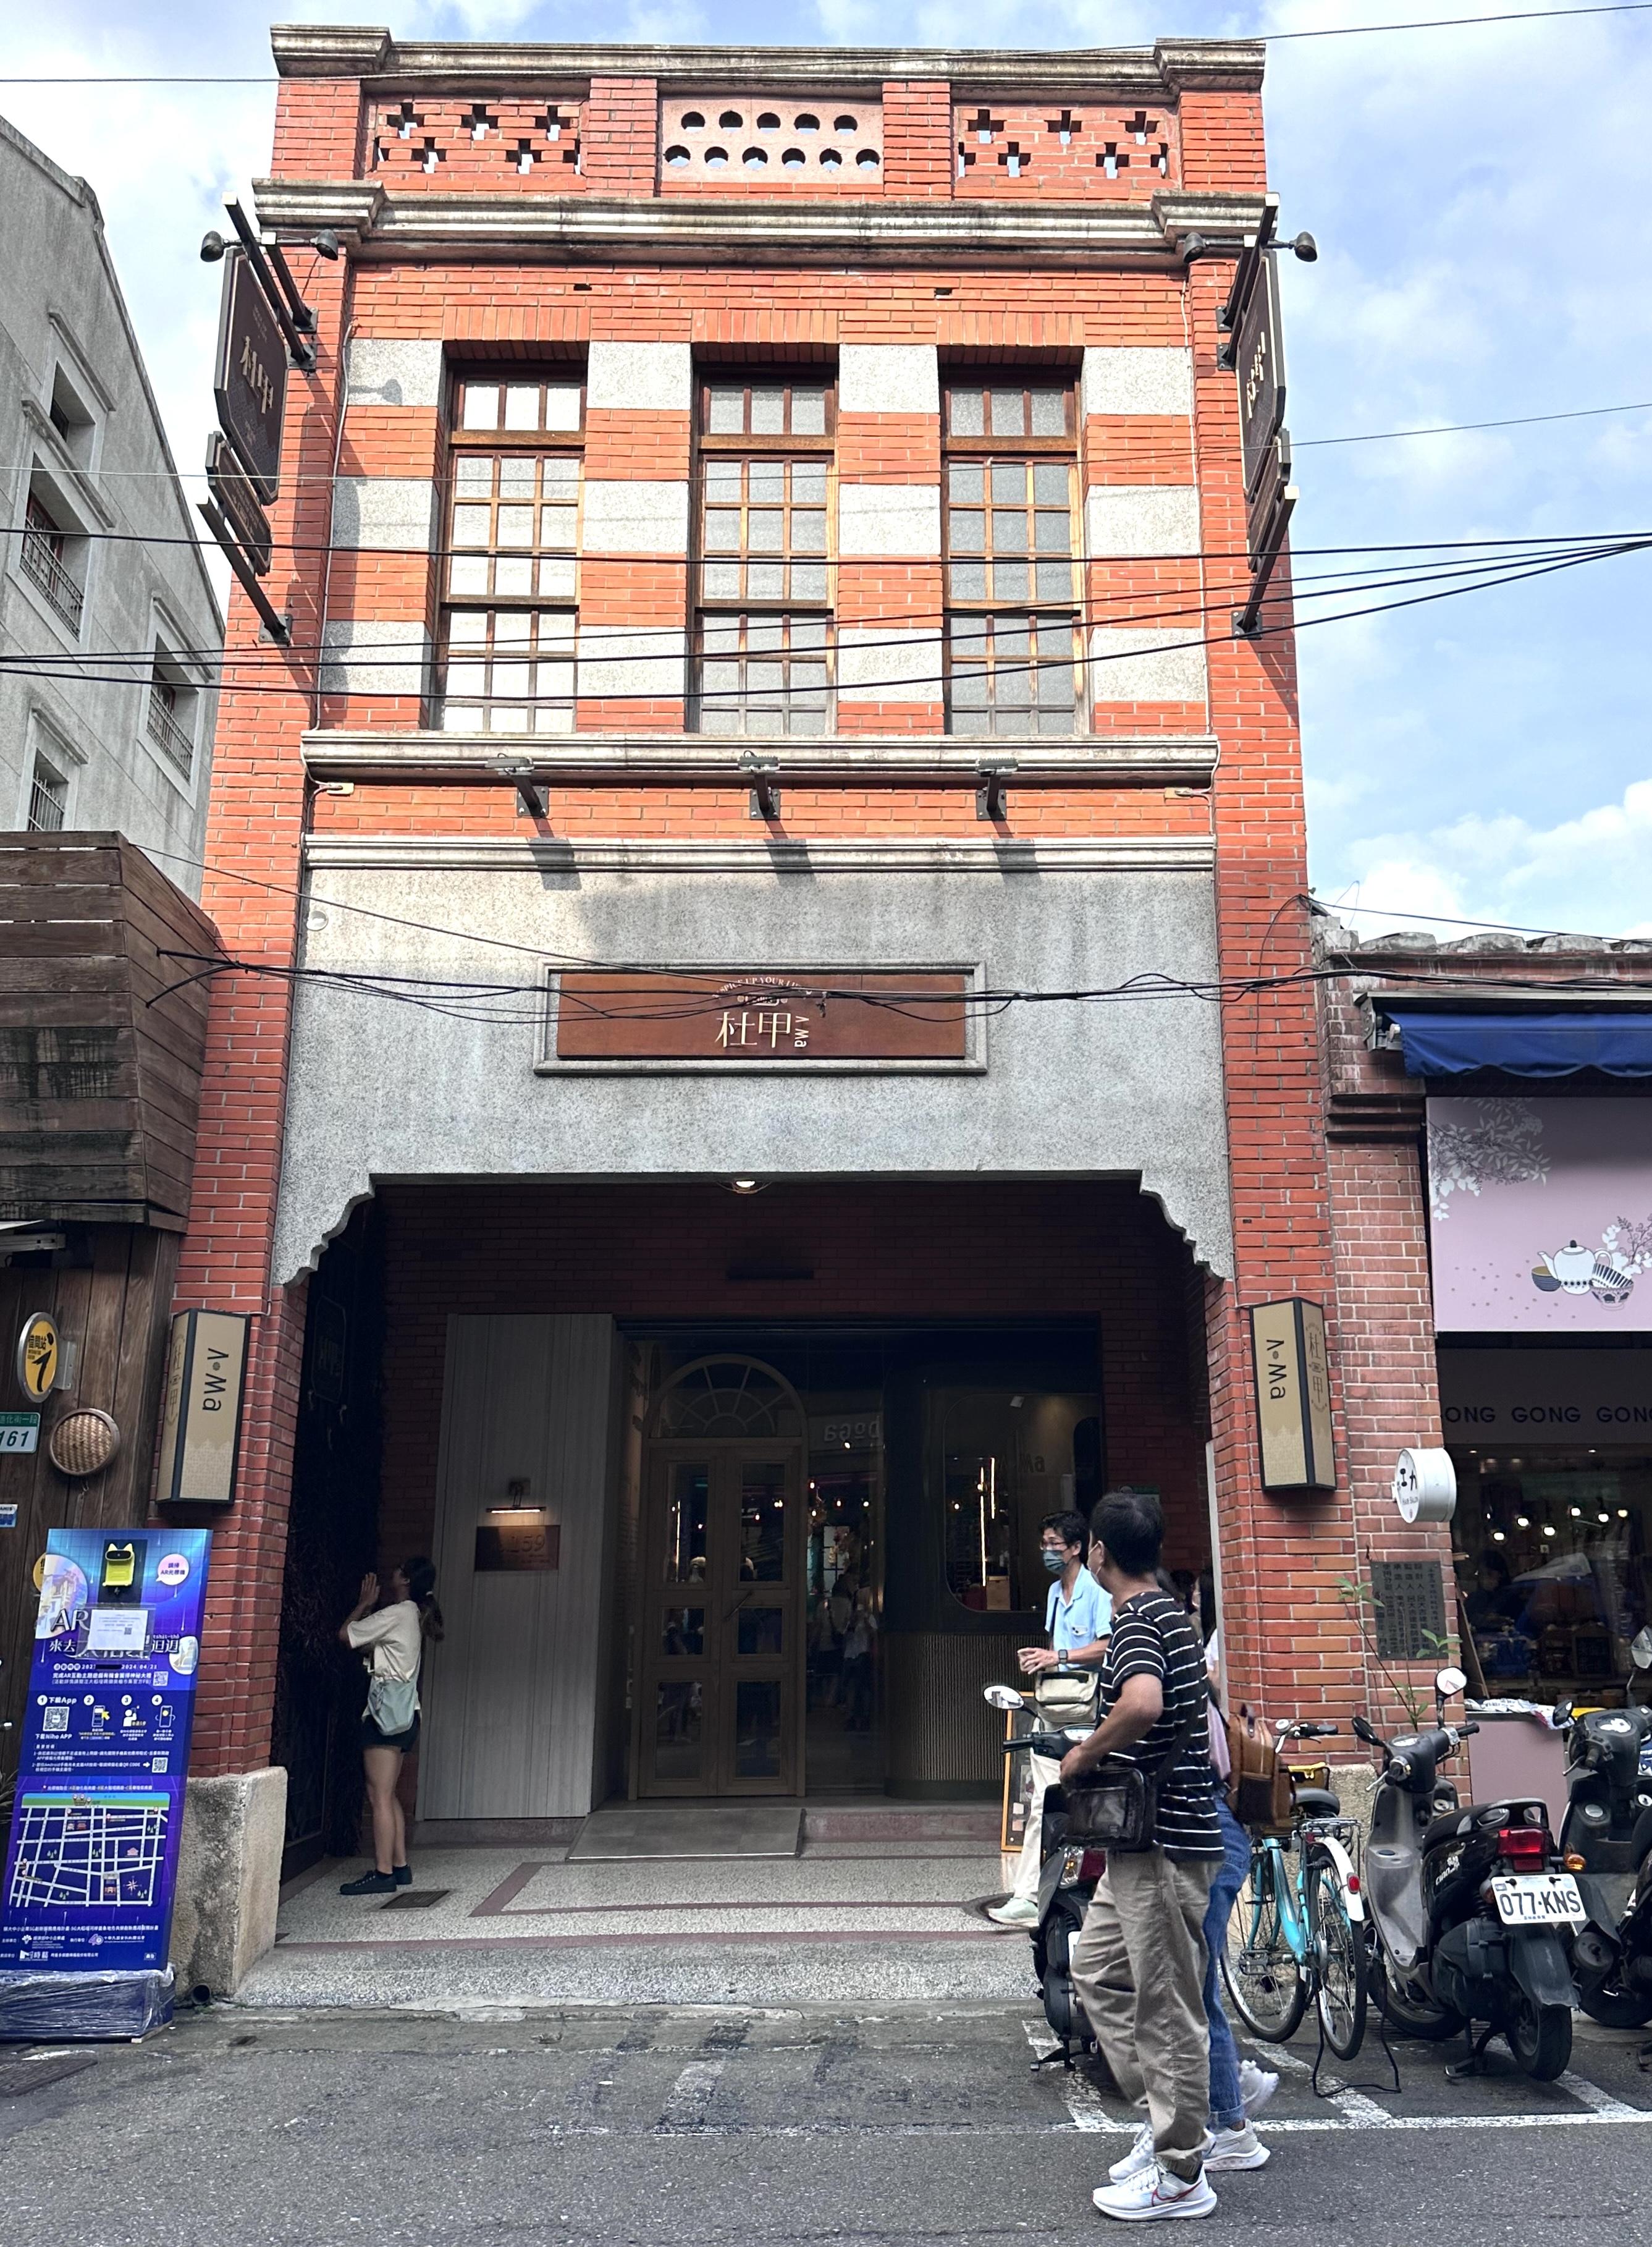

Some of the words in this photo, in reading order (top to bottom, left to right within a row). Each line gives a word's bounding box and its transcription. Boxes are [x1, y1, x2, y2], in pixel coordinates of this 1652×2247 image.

[761, 976, 785, 986] YOUR
[714, 1011, 791, 1049] 杜甲
[1440, 1407, 1496, 1423] ONG
[1511, 1407, 1581, 1423] GONG
[1596, 1407, 1652, 1423] GON
[0, 1430, 30, 1447] 161
[50, 1608, 91, 1633] AR
[49, 1640, 76, 1654] 來去
[49, 1696, 77, 1704] 下載App
